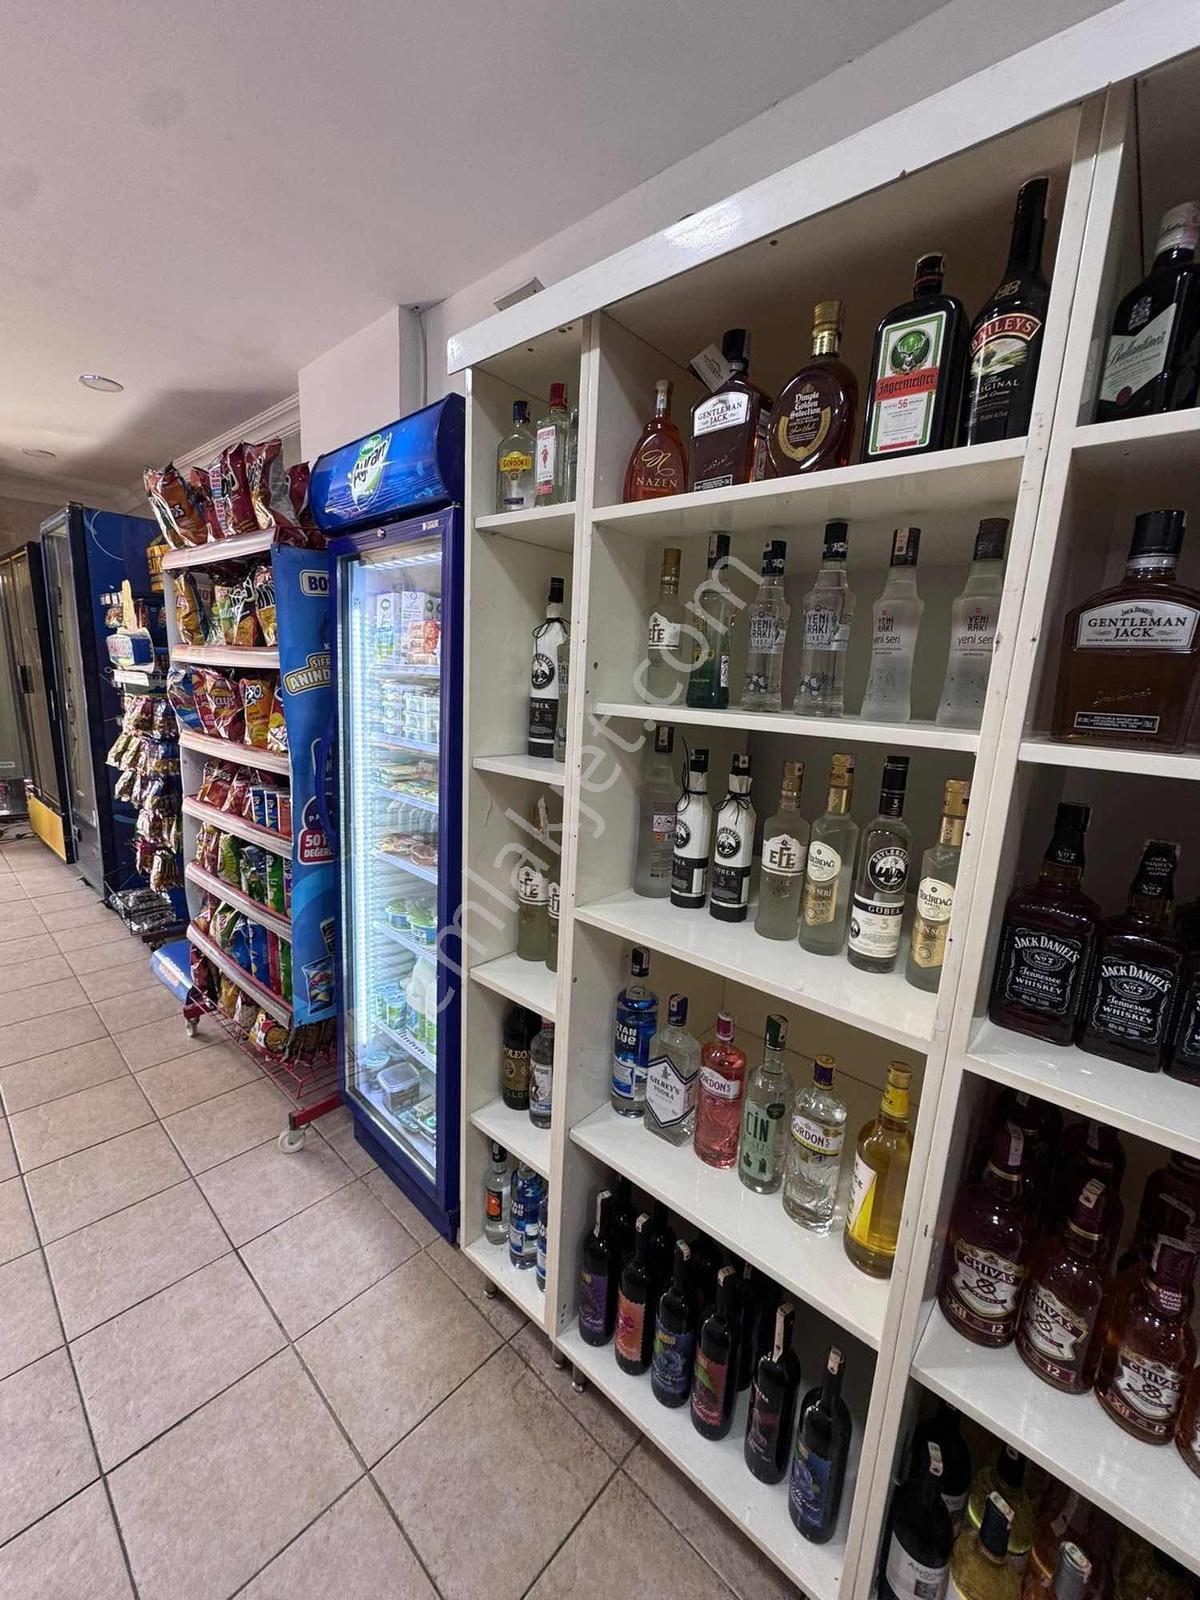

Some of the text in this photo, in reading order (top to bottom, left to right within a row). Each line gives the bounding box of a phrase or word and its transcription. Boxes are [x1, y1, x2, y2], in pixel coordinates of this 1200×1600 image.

[794, 391, 820, 403] Dimple
[897, 398, 909, 409] 56
[697, 401, 743, 422] GENTLEMAN
[789, 407, 821, 420] Selection
[794, 400, 818, 411] Golden
[710, 412, 728, 426] JACK
[636, 476, 677, 488] NAZEN
[307, 575, 329, 591] BO
[807, 624, 829, 634] RAKI
[967, 623, 987, 632] RAKI
[1087, 617, 1188, 628] GENTLEMAN
[957, 634, 976, 647] yeni
[1114, 628, 1154, 639] JACK
[290, 669, 330, 690] ANIND
[769, 847, 797, 870] EFE
[1014, 936, 1080, 964] JACK DANIEL'S
[1019, 966, 1062, 984] Tennessee
[1101, 964, 1172, 993] JACK DANIEL'S
[1015, 976, 1063, 994] WHISKEY
[1107, 994, 1152, 1014] Tennessee
[1102, 1005, 1154, 1024] WHISKEY
[650, 1075, 680, 1095] GILBEY'S
[654, 1084, 675, 1101] VODKA
[963, 1256, 1016, 1283] CHIVAS
[1030, 1289, 1073, 1331] CHIVAS
[991, 1324, 1004, 1333] 12
[1047, 1363, 1060, 1377] 12
[1129, 1362, 1181, 1391] CHIVAS
[1153, 1422, 1167, 1433] 12
